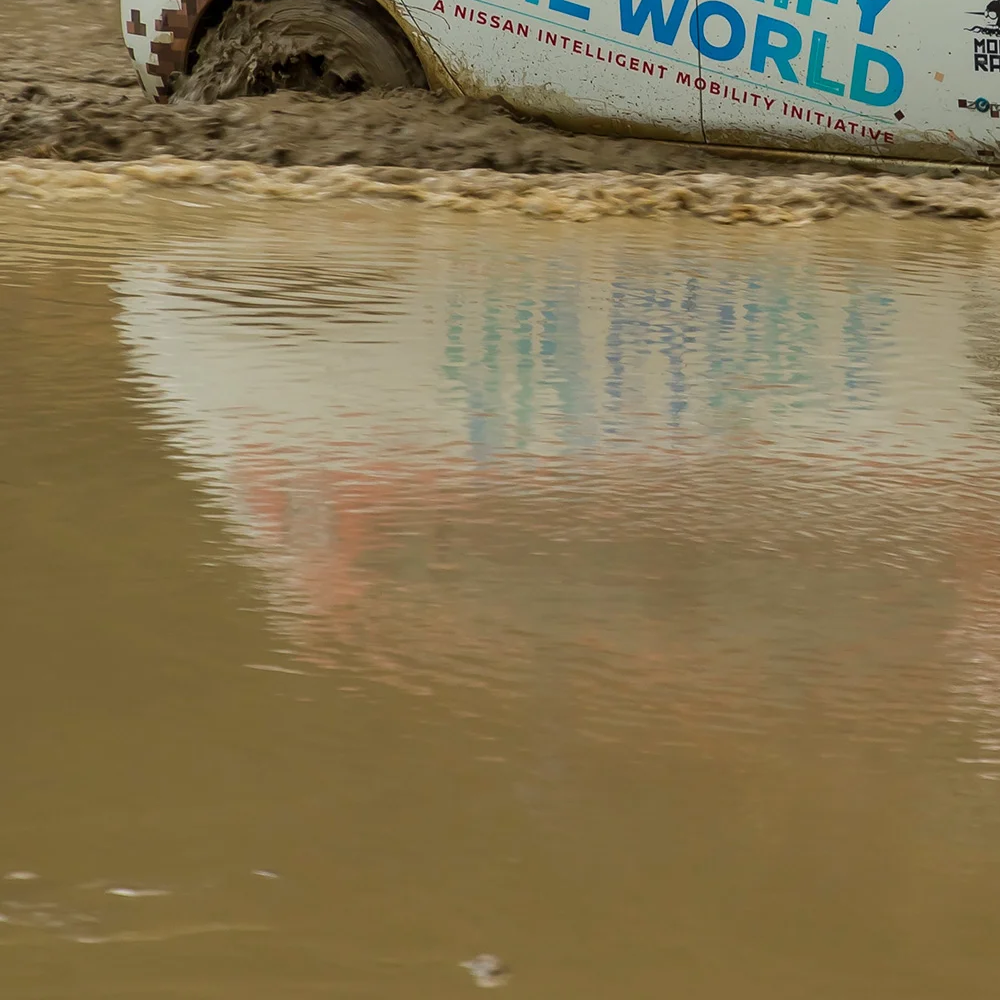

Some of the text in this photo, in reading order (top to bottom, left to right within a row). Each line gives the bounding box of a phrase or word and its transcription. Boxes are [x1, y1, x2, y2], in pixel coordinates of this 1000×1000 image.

[432, 0, 895, 144] A NISSAN INTELLIGENT MOBILITY INITIATIVE
